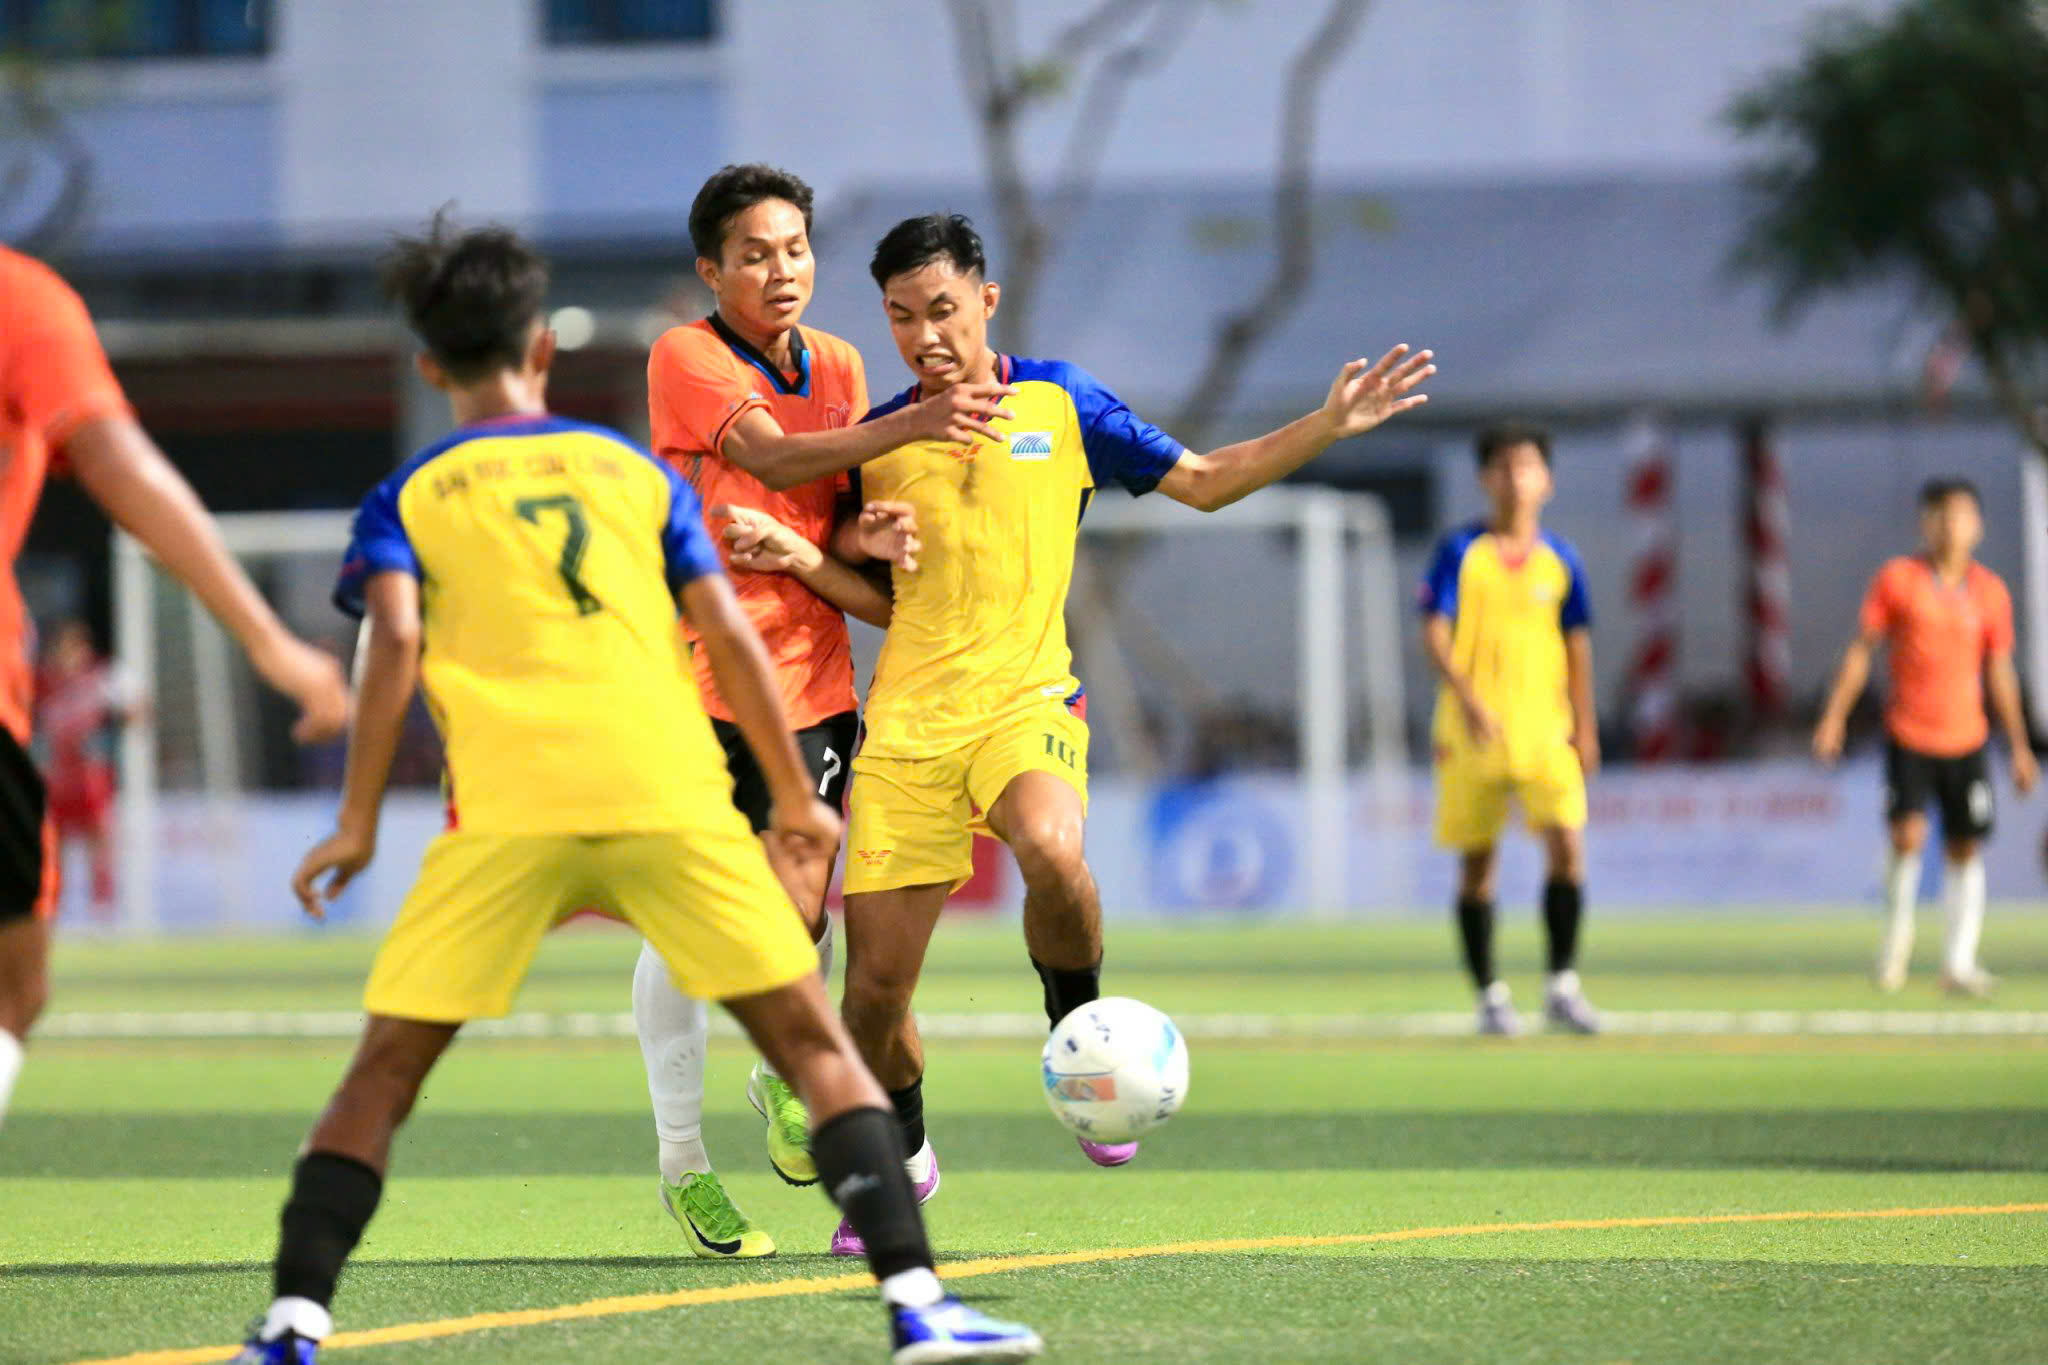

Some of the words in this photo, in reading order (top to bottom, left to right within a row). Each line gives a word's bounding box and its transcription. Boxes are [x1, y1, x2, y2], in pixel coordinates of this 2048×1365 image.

[515, 494, 603, 616] 7
[818, 746, 841, 797] 7
[1042, 733, 1075, 769] 10
